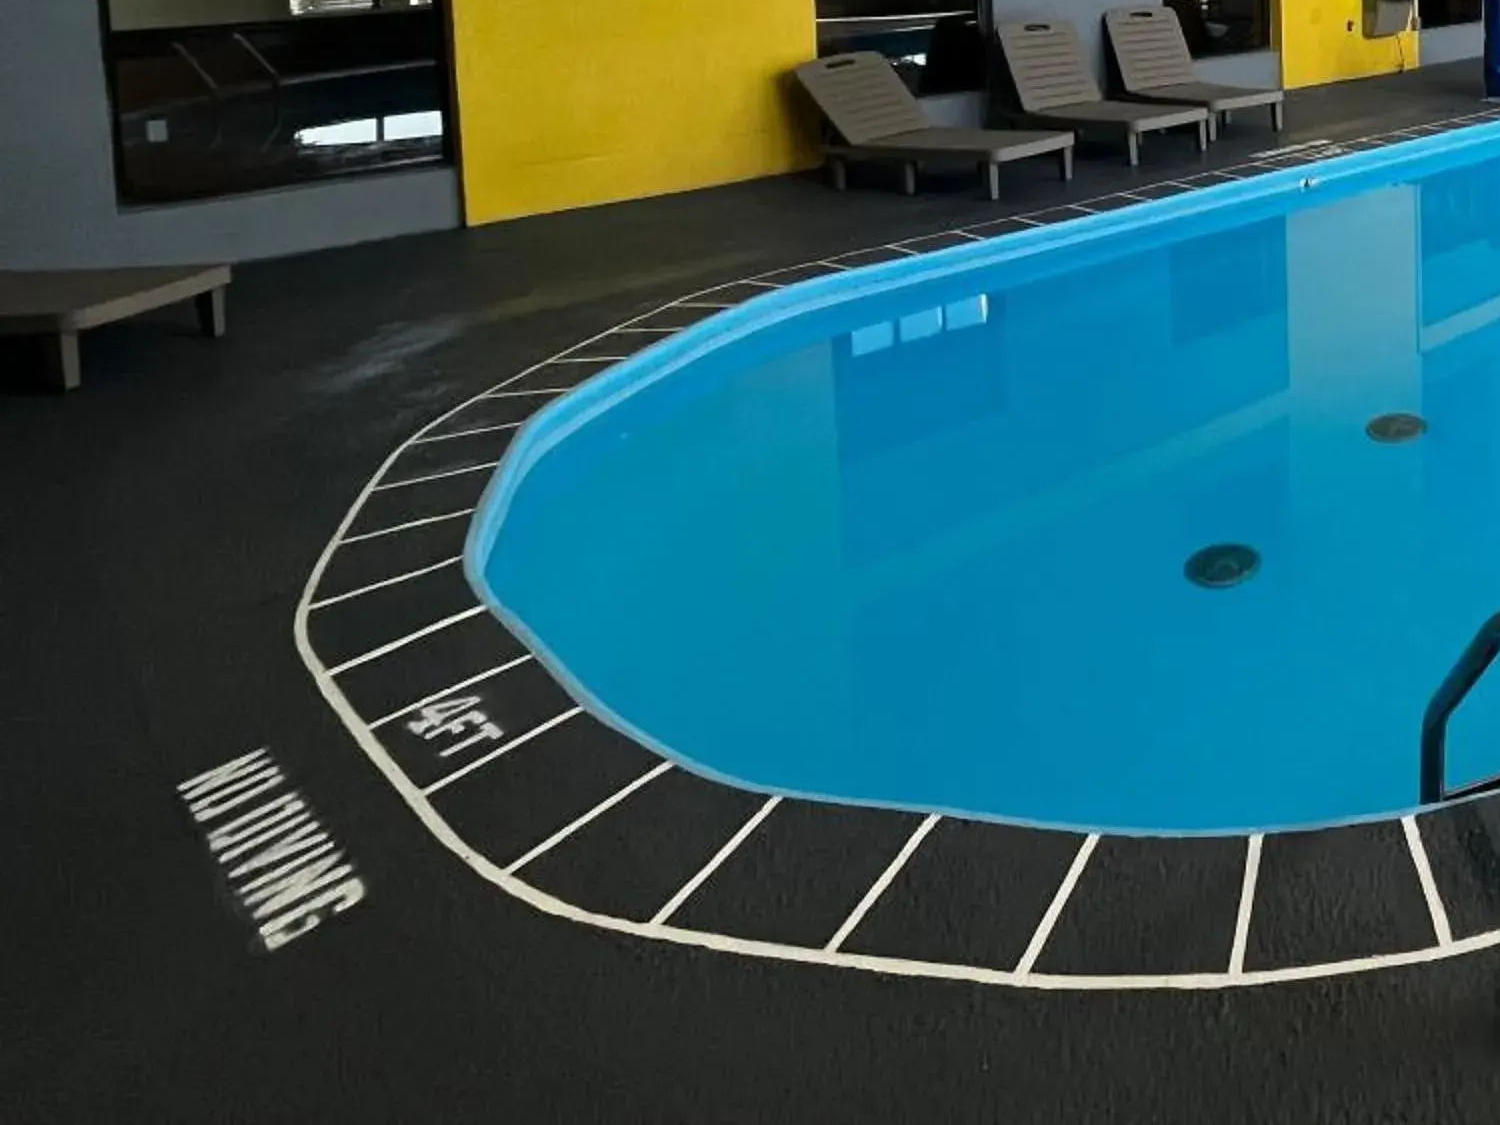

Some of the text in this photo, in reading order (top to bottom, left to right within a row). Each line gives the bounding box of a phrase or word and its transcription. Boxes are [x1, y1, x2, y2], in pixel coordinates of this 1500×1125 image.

[406, 695, 504, 758] 4FT
[176, 746, 366, 952] NO DIVING
